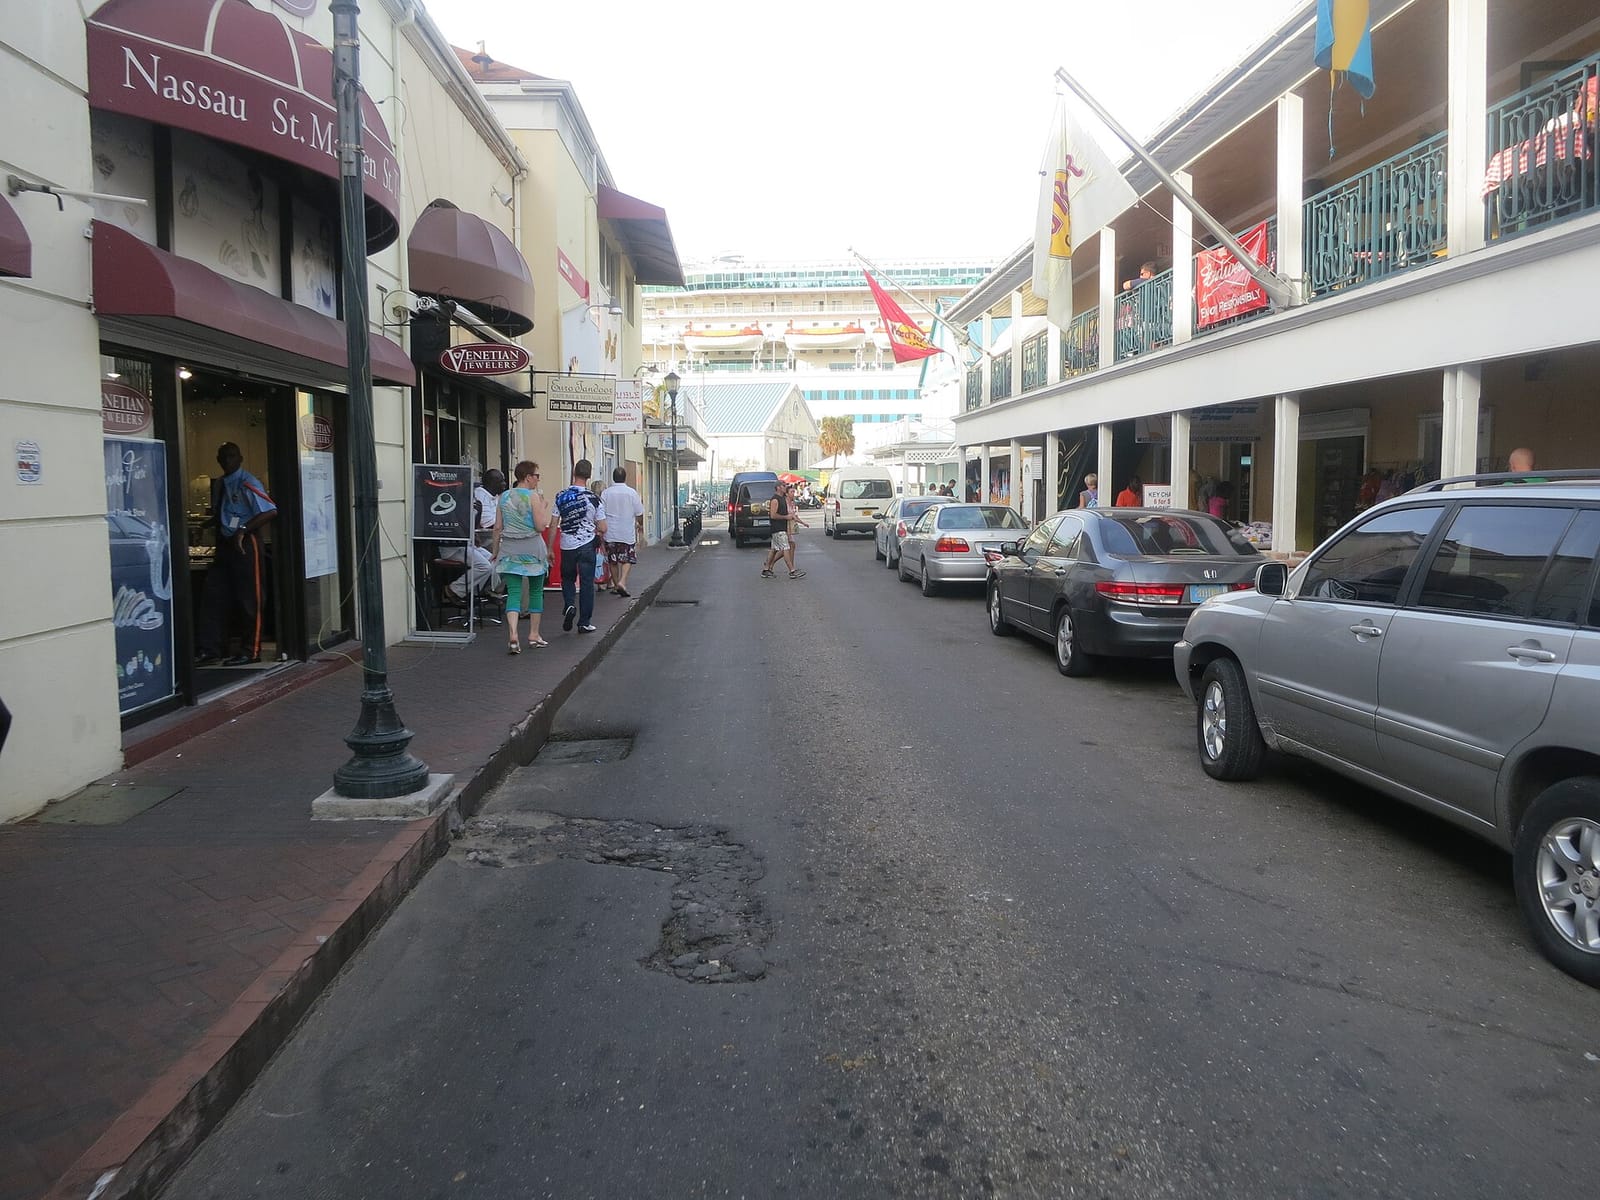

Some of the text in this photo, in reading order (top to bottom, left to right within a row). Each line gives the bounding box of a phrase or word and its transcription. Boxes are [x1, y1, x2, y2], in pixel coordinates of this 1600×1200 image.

[121, 46, 248, 122] Nassau
[446, 349, 519, 372] VENETIAN
[463, 361, 517, 371] JEWELERS
[550, 379, 613, 393] Euro Tandoor
[616, 391, 640, 399] UBLE
[102, 393, 145, 412] NETIAN
[616, 401, 641, 409] AGON
[102, 412, 143, 425] EWELERS
